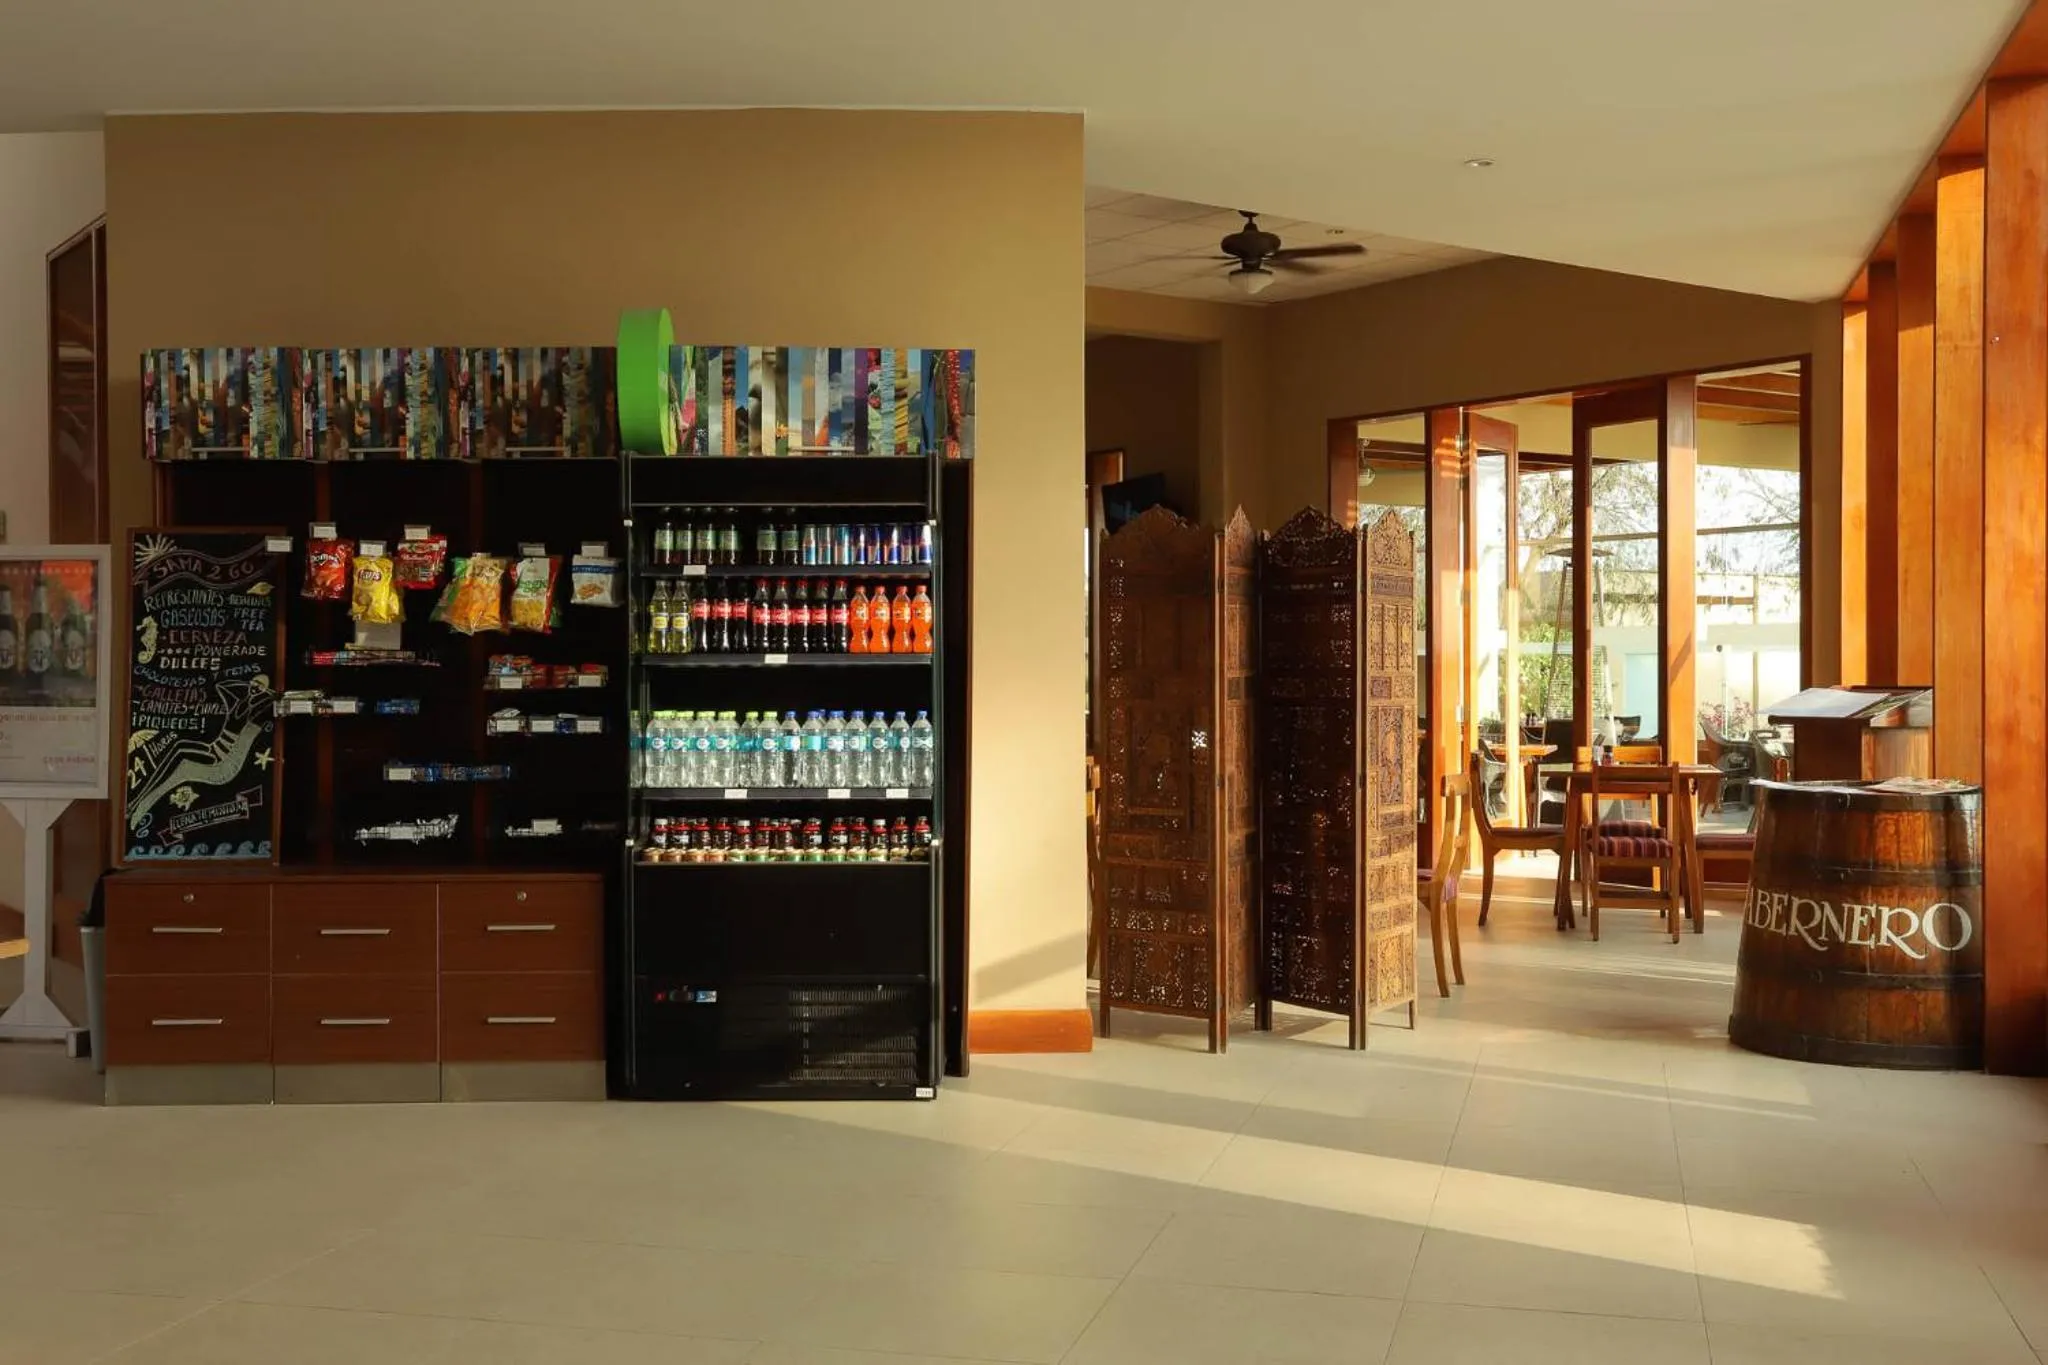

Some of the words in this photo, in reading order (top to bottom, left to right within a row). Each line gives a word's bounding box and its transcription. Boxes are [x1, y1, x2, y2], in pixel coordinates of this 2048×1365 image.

[208, 565, 222, 580] 2
[240, 619, 264, 632] TEA
[169, 628, 247, 644] CERVEZA
[193, 644, 268, 657] POWERADE
[159, 656, 222, 671] DULCES
[141, 684, 208, 703] GALLETAS
